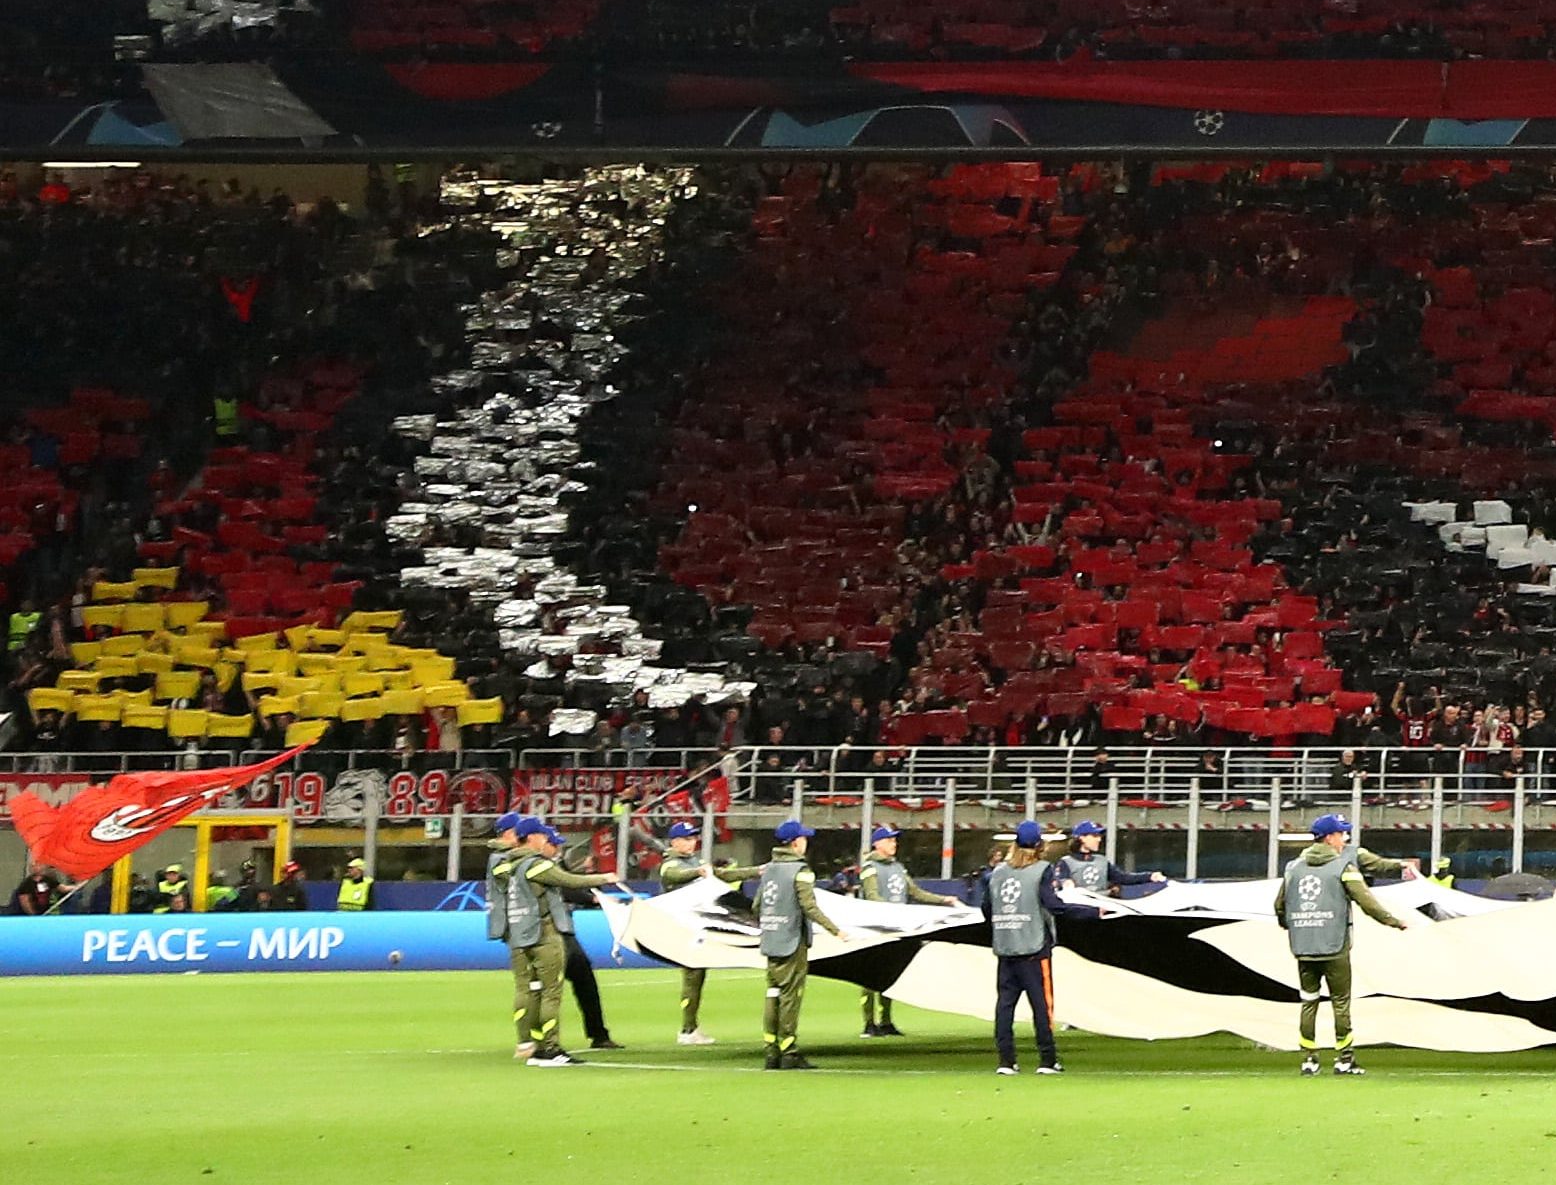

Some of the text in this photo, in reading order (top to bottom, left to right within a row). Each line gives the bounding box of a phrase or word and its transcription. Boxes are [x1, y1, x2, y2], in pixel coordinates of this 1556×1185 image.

[386, 769, 449, 824] 89
[82, 927, 209, 962] PEACE
[247, 927, 345, 960] МИР
